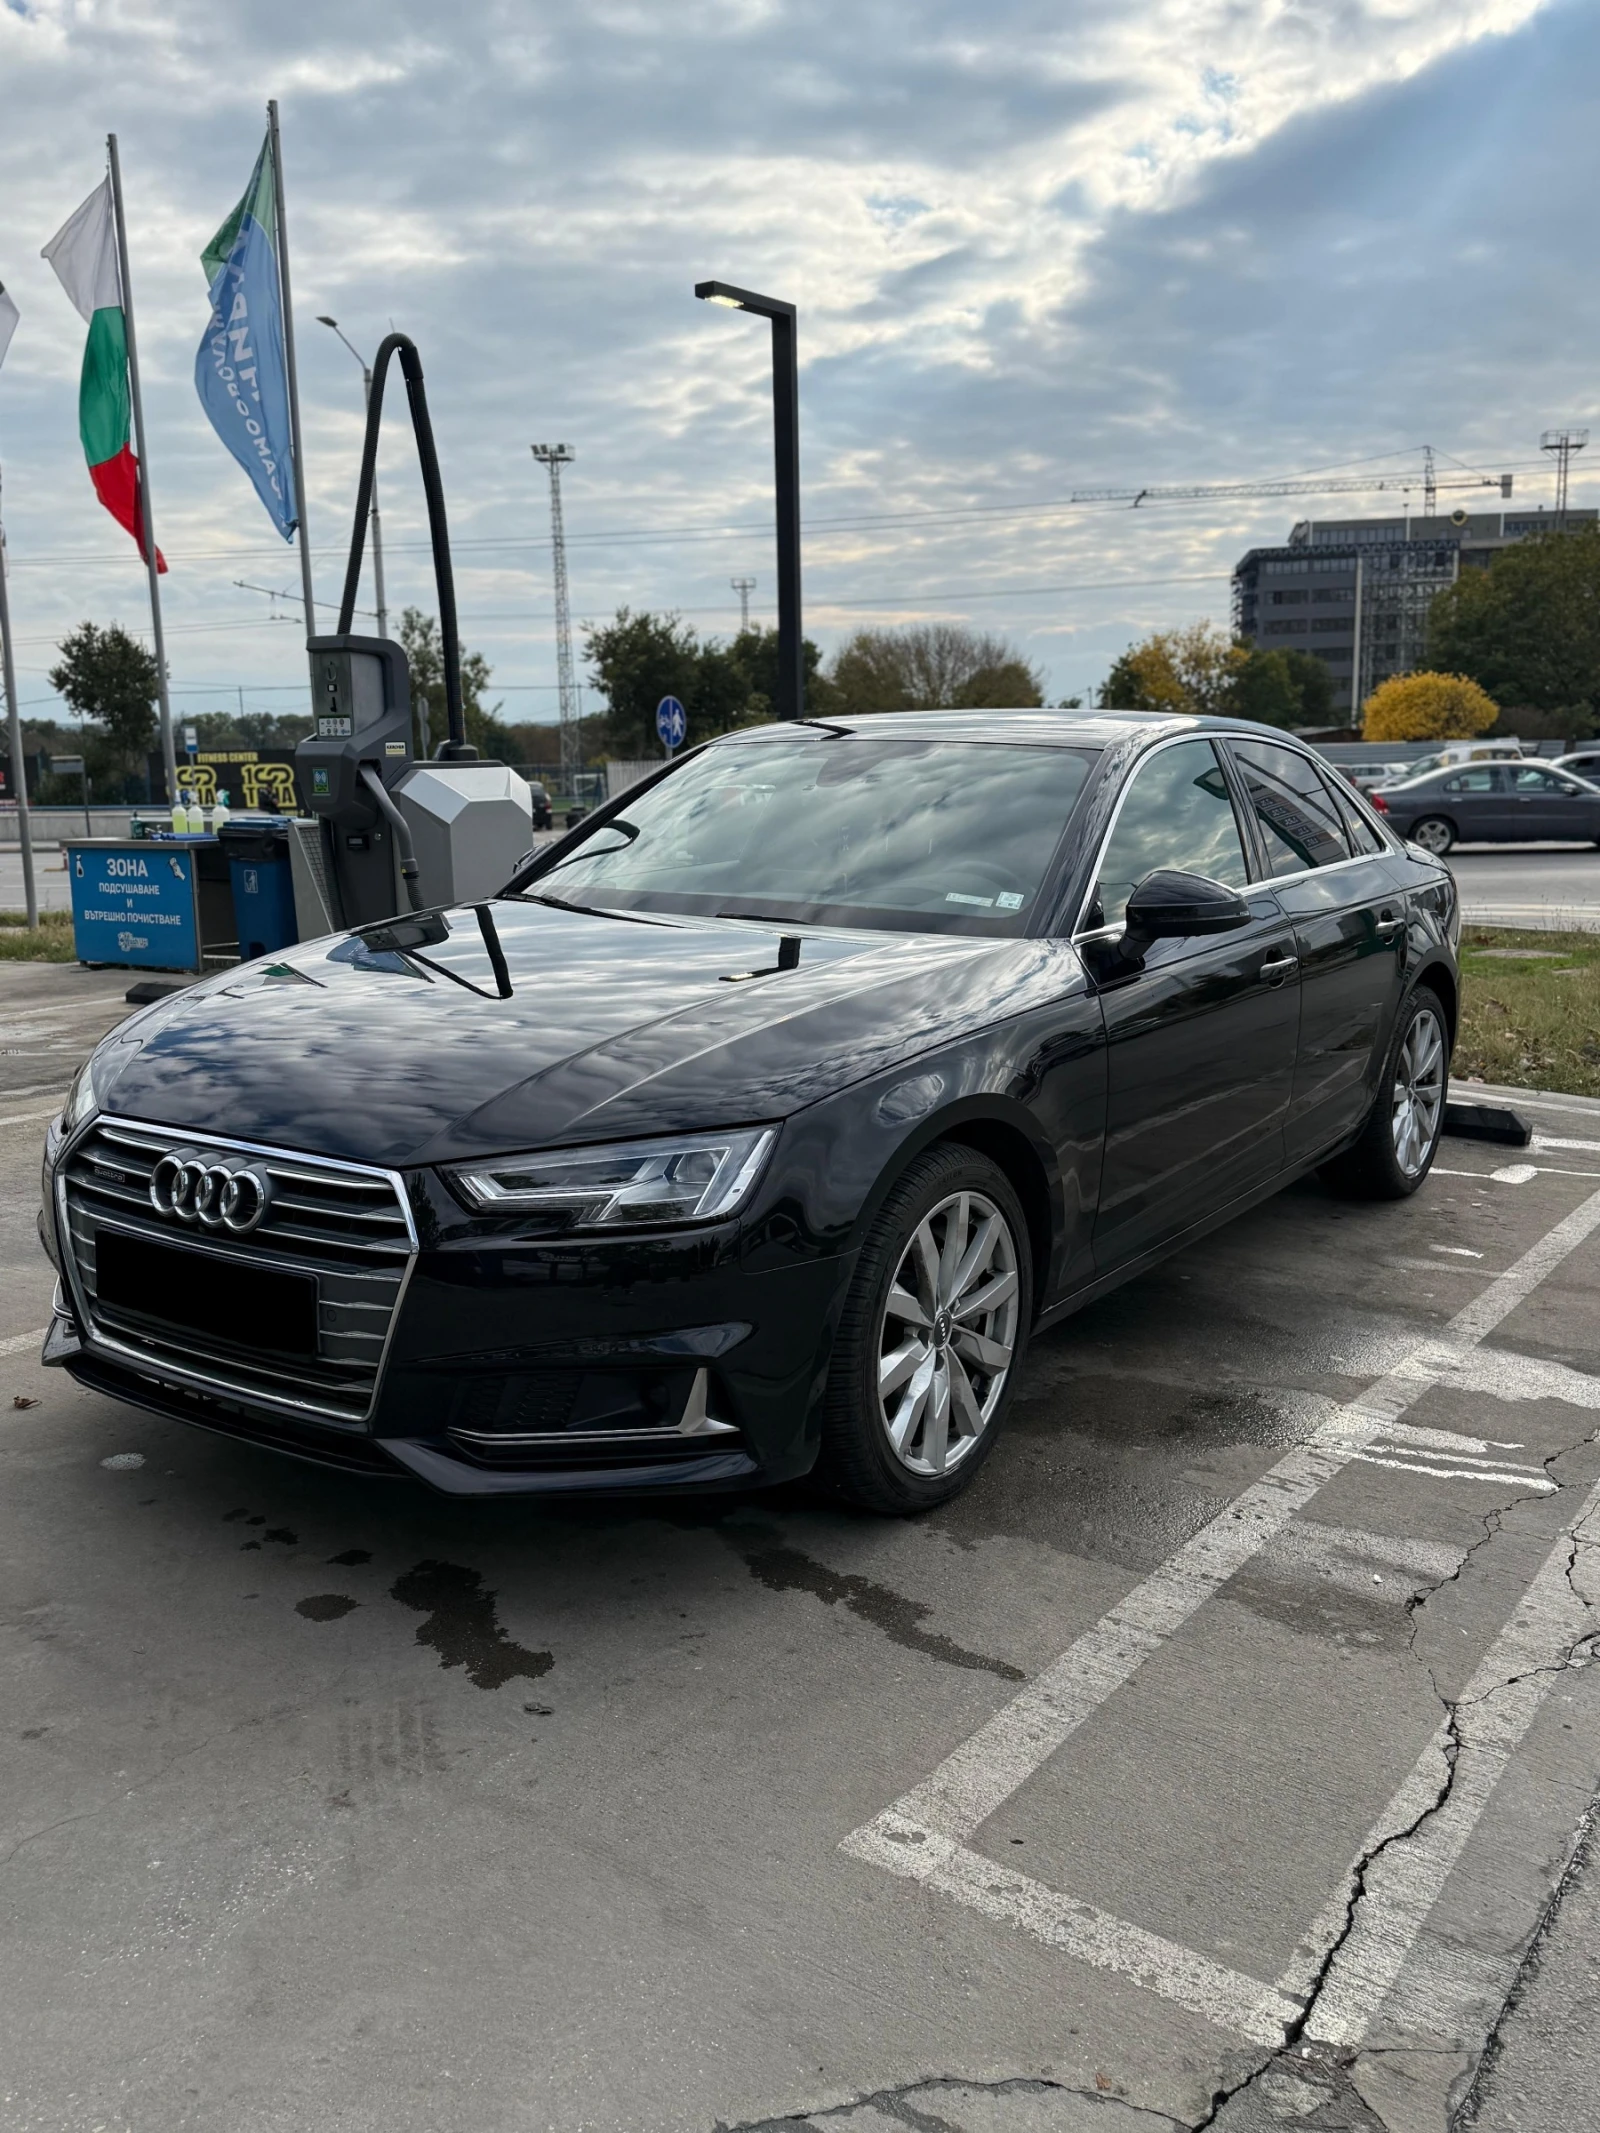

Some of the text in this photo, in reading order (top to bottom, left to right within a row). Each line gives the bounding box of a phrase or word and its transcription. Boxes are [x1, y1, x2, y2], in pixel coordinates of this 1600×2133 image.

[197, 752, 258, 763] FITNESS CENTER
[106, 857, 148, 878] ЗОНА
[98, 882, 160, 895] ПОДСУШАВАНЕ
[126, 898, 133, 909] И
[84, 909, 181, 925] ВЪТРЕШНО ПОЧИСТВАНЕ
[94, 1168, 123, 1181] quattro
